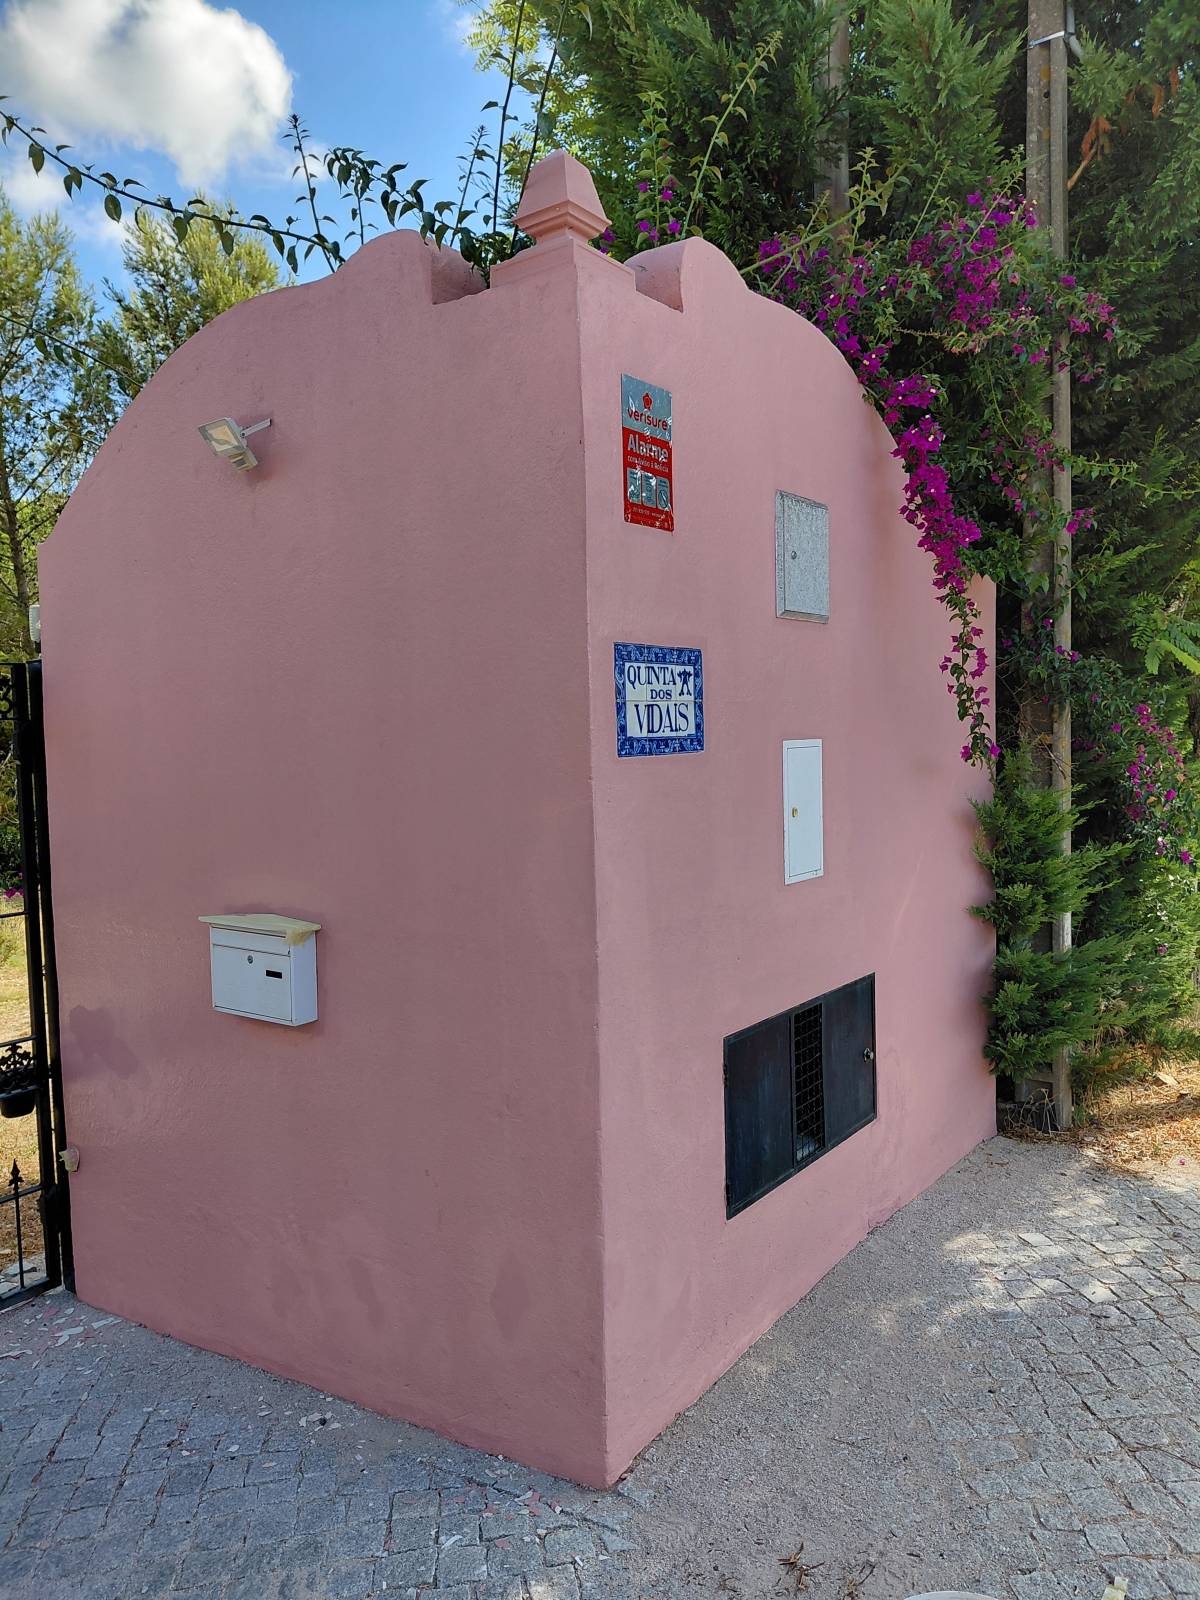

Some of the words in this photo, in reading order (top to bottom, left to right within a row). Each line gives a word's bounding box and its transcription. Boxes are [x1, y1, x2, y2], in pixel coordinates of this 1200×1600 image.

[627, 407, 668, 431] verisure
[628, 433, 669, 462] Alarme
[627, 665, 676, 689] QUINTA
[650, 689, 672, 700] DOS
[634, 703, 689, 734] VIDAIS
